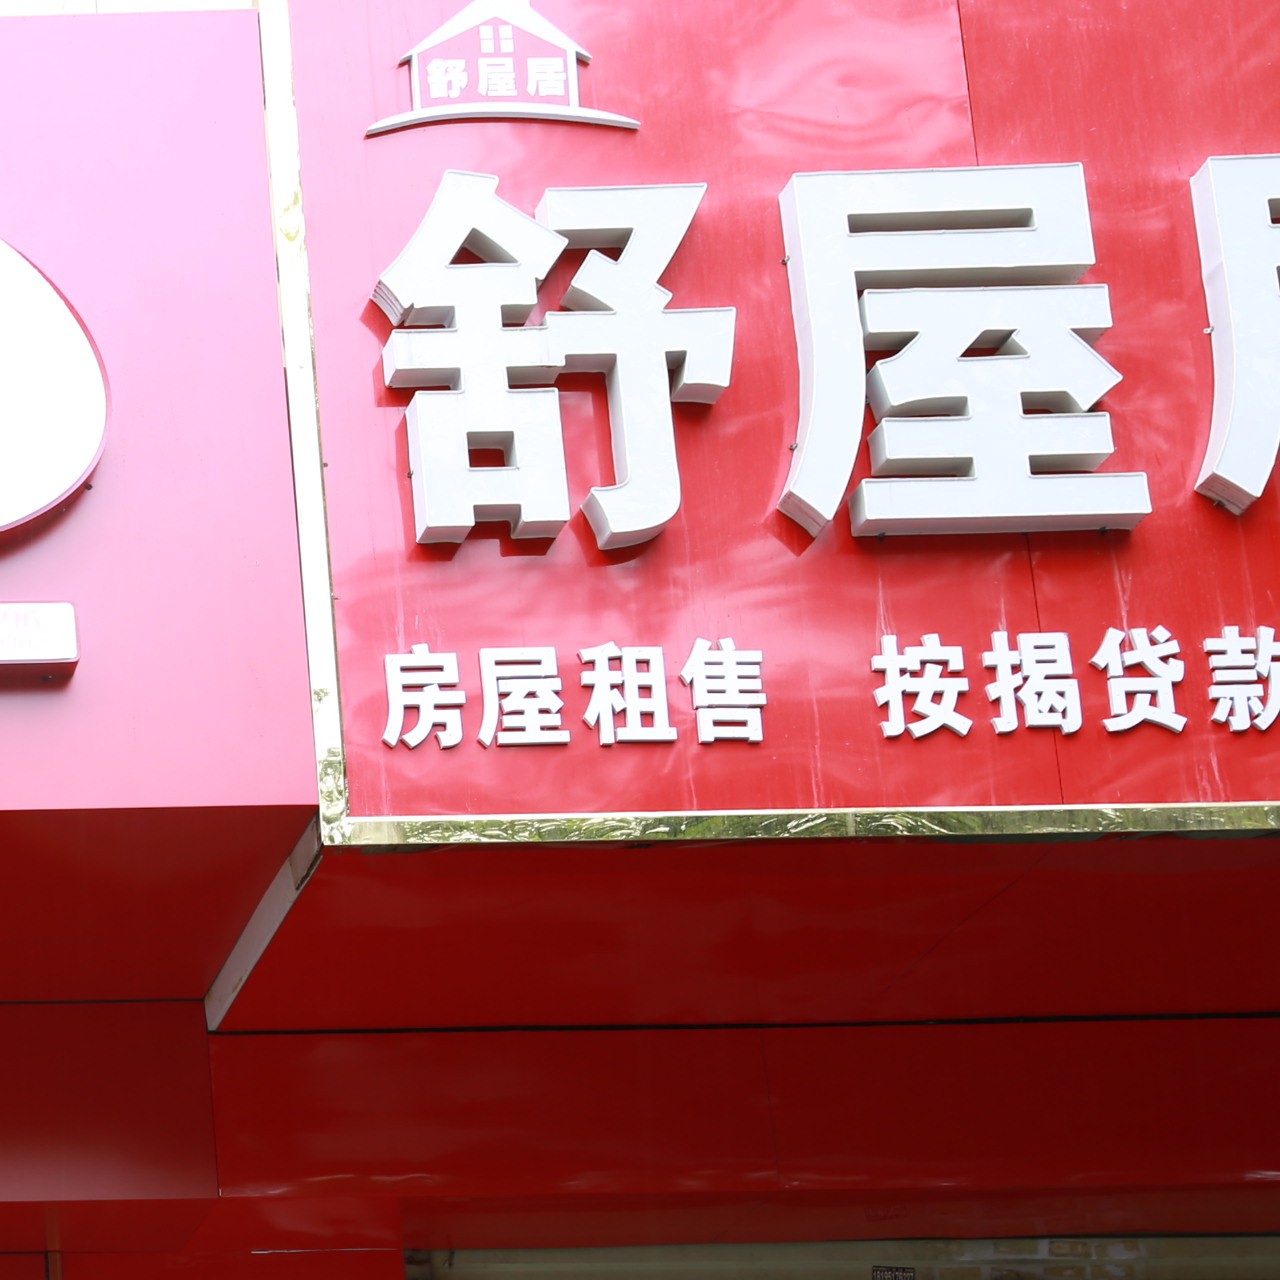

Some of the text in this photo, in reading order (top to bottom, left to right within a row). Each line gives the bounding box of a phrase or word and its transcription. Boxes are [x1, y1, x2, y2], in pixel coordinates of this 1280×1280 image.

[426, 56, 567, 99] 舒屋居
[370, 155, 1280, 552] 舒屋
[382, 625, 1280, 750] 房屋租售 按揭贷款
